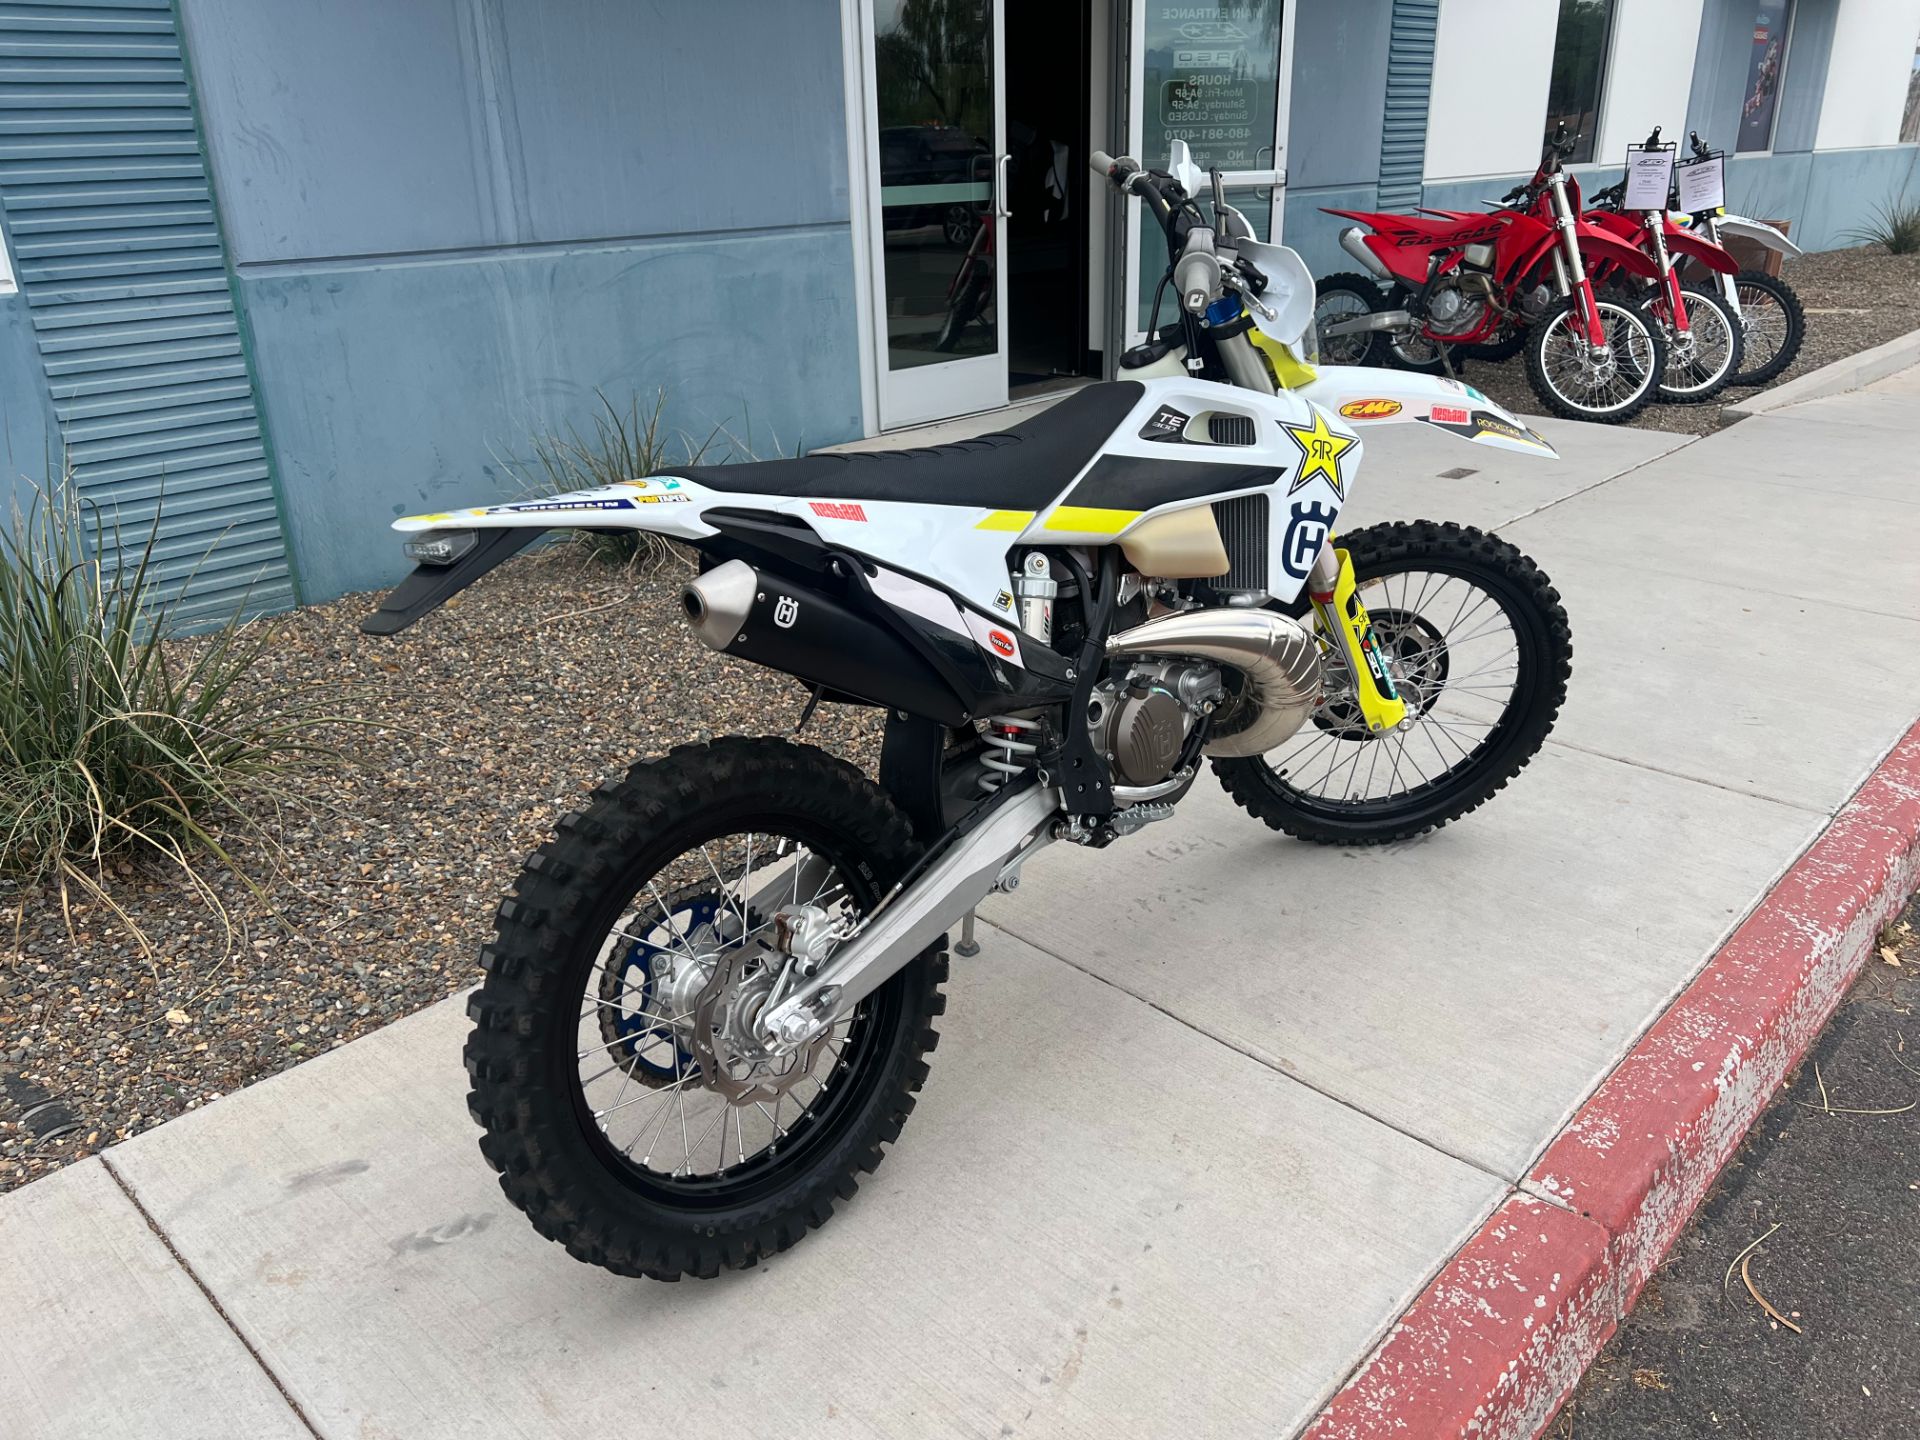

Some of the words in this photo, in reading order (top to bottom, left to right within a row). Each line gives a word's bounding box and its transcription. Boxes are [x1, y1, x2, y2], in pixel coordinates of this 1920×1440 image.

[1341, 400, 1401, 416] FMF
[1160, 412, 1186, 427] TE
[519, 501, 619, 511] MICHELIN
